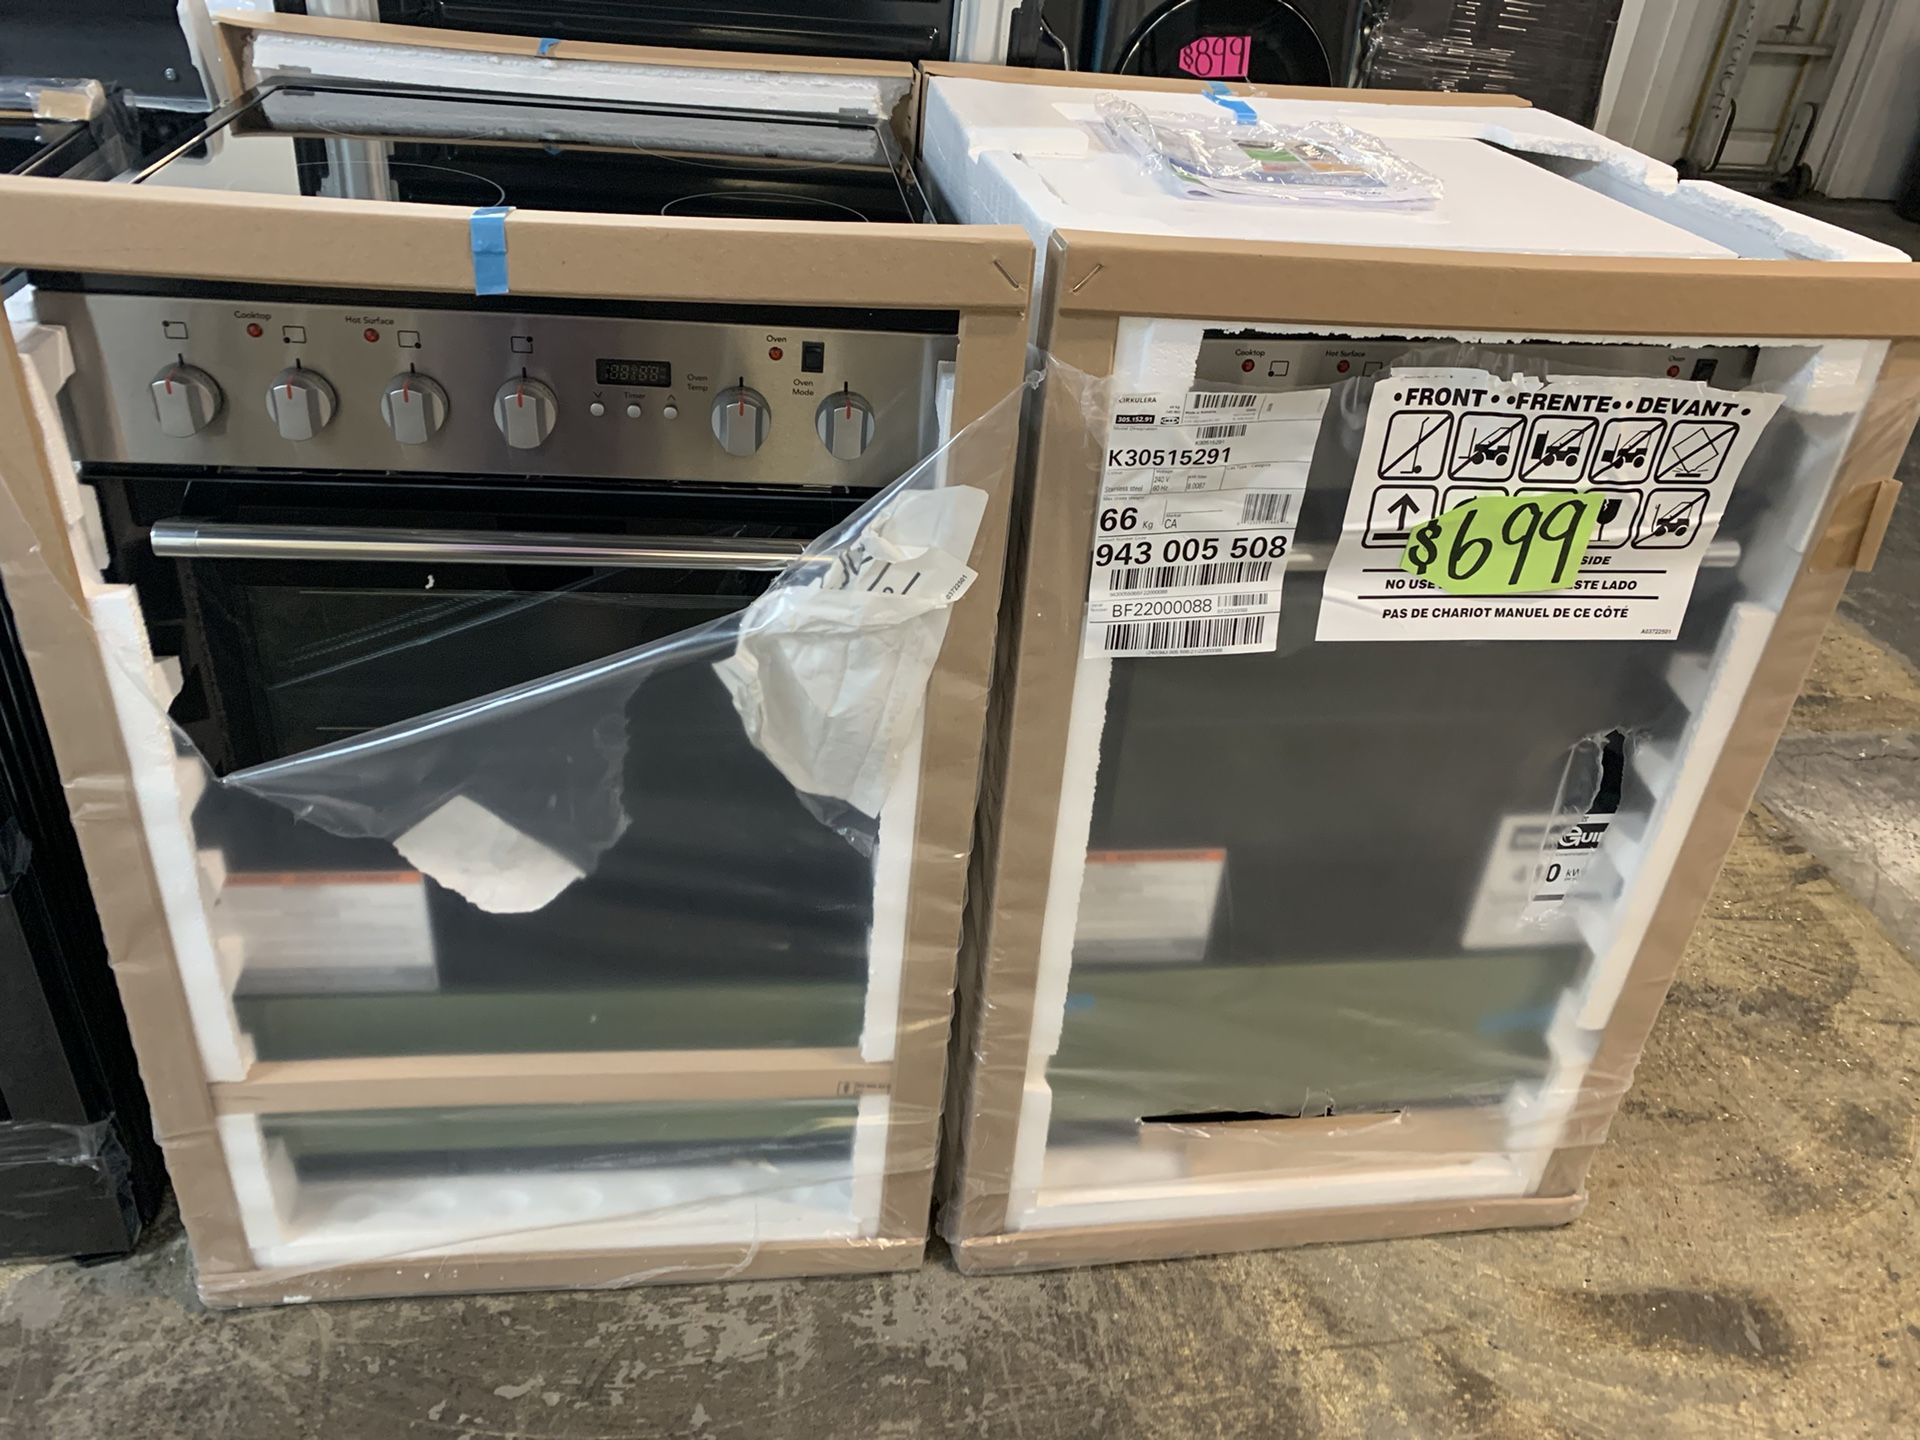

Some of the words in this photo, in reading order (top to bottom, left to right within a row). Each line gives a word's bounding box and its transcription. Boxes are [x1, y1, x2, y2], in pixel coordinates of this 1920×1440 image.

[1183, 37, 1245, 76] $899
[234, 310, 272, 321] Cooktop
[345, 316, 361, 324] Hot
[363, 316, 394, 326] Surface
[766, 334, 787, 343] Oven
[1235, 349, 1266, 357] Cooktop
[686, 373, 708, 382] Oven
[792, 378, 814, 387] Oven
[687, 384, 709, 393] Temp
[792, 388, 815, 396] Mode
[624, 391, 646, 400] Timer
[1405, 387, 1488, 407] FRONT
[1515, 392, 1613, 414] FRENTE
[1635, 396, 1740, 418] DEVANT
[1108, 447, 1231, 467] K30515291
[1100, 506, 1138, 532] 66
[1142, 521, 1154, 531] Kg
[1164, 518, 1178, 529] CA
[1407, 500, 1589, 586] $699
[1095, 541, 1153, 567] 943
[1162, 538, 1220, 563] 005
[1230, 535, 1288, 559] 508
[1581, 556, 1612, 565] SIDE
[1385, 579, 1406, 589] NO
[1565, 580, 1600, 590] STE
[1601, 580, 1638, 590] LADO
[1112, 598, 1213, 618] BF22000088
[1382, 608, 1408, 619] PAS
[1411, 608, 1429, 618] DE
[1432, 607, 1493, 618] CHARIOT
[1494, 607, 1550, 618] MANUEL
[1553, 608, 1571, 618] DE
[1573, 608, 1591, 618] CE
[1593, 605, 1629, 618] CÔTÉ
